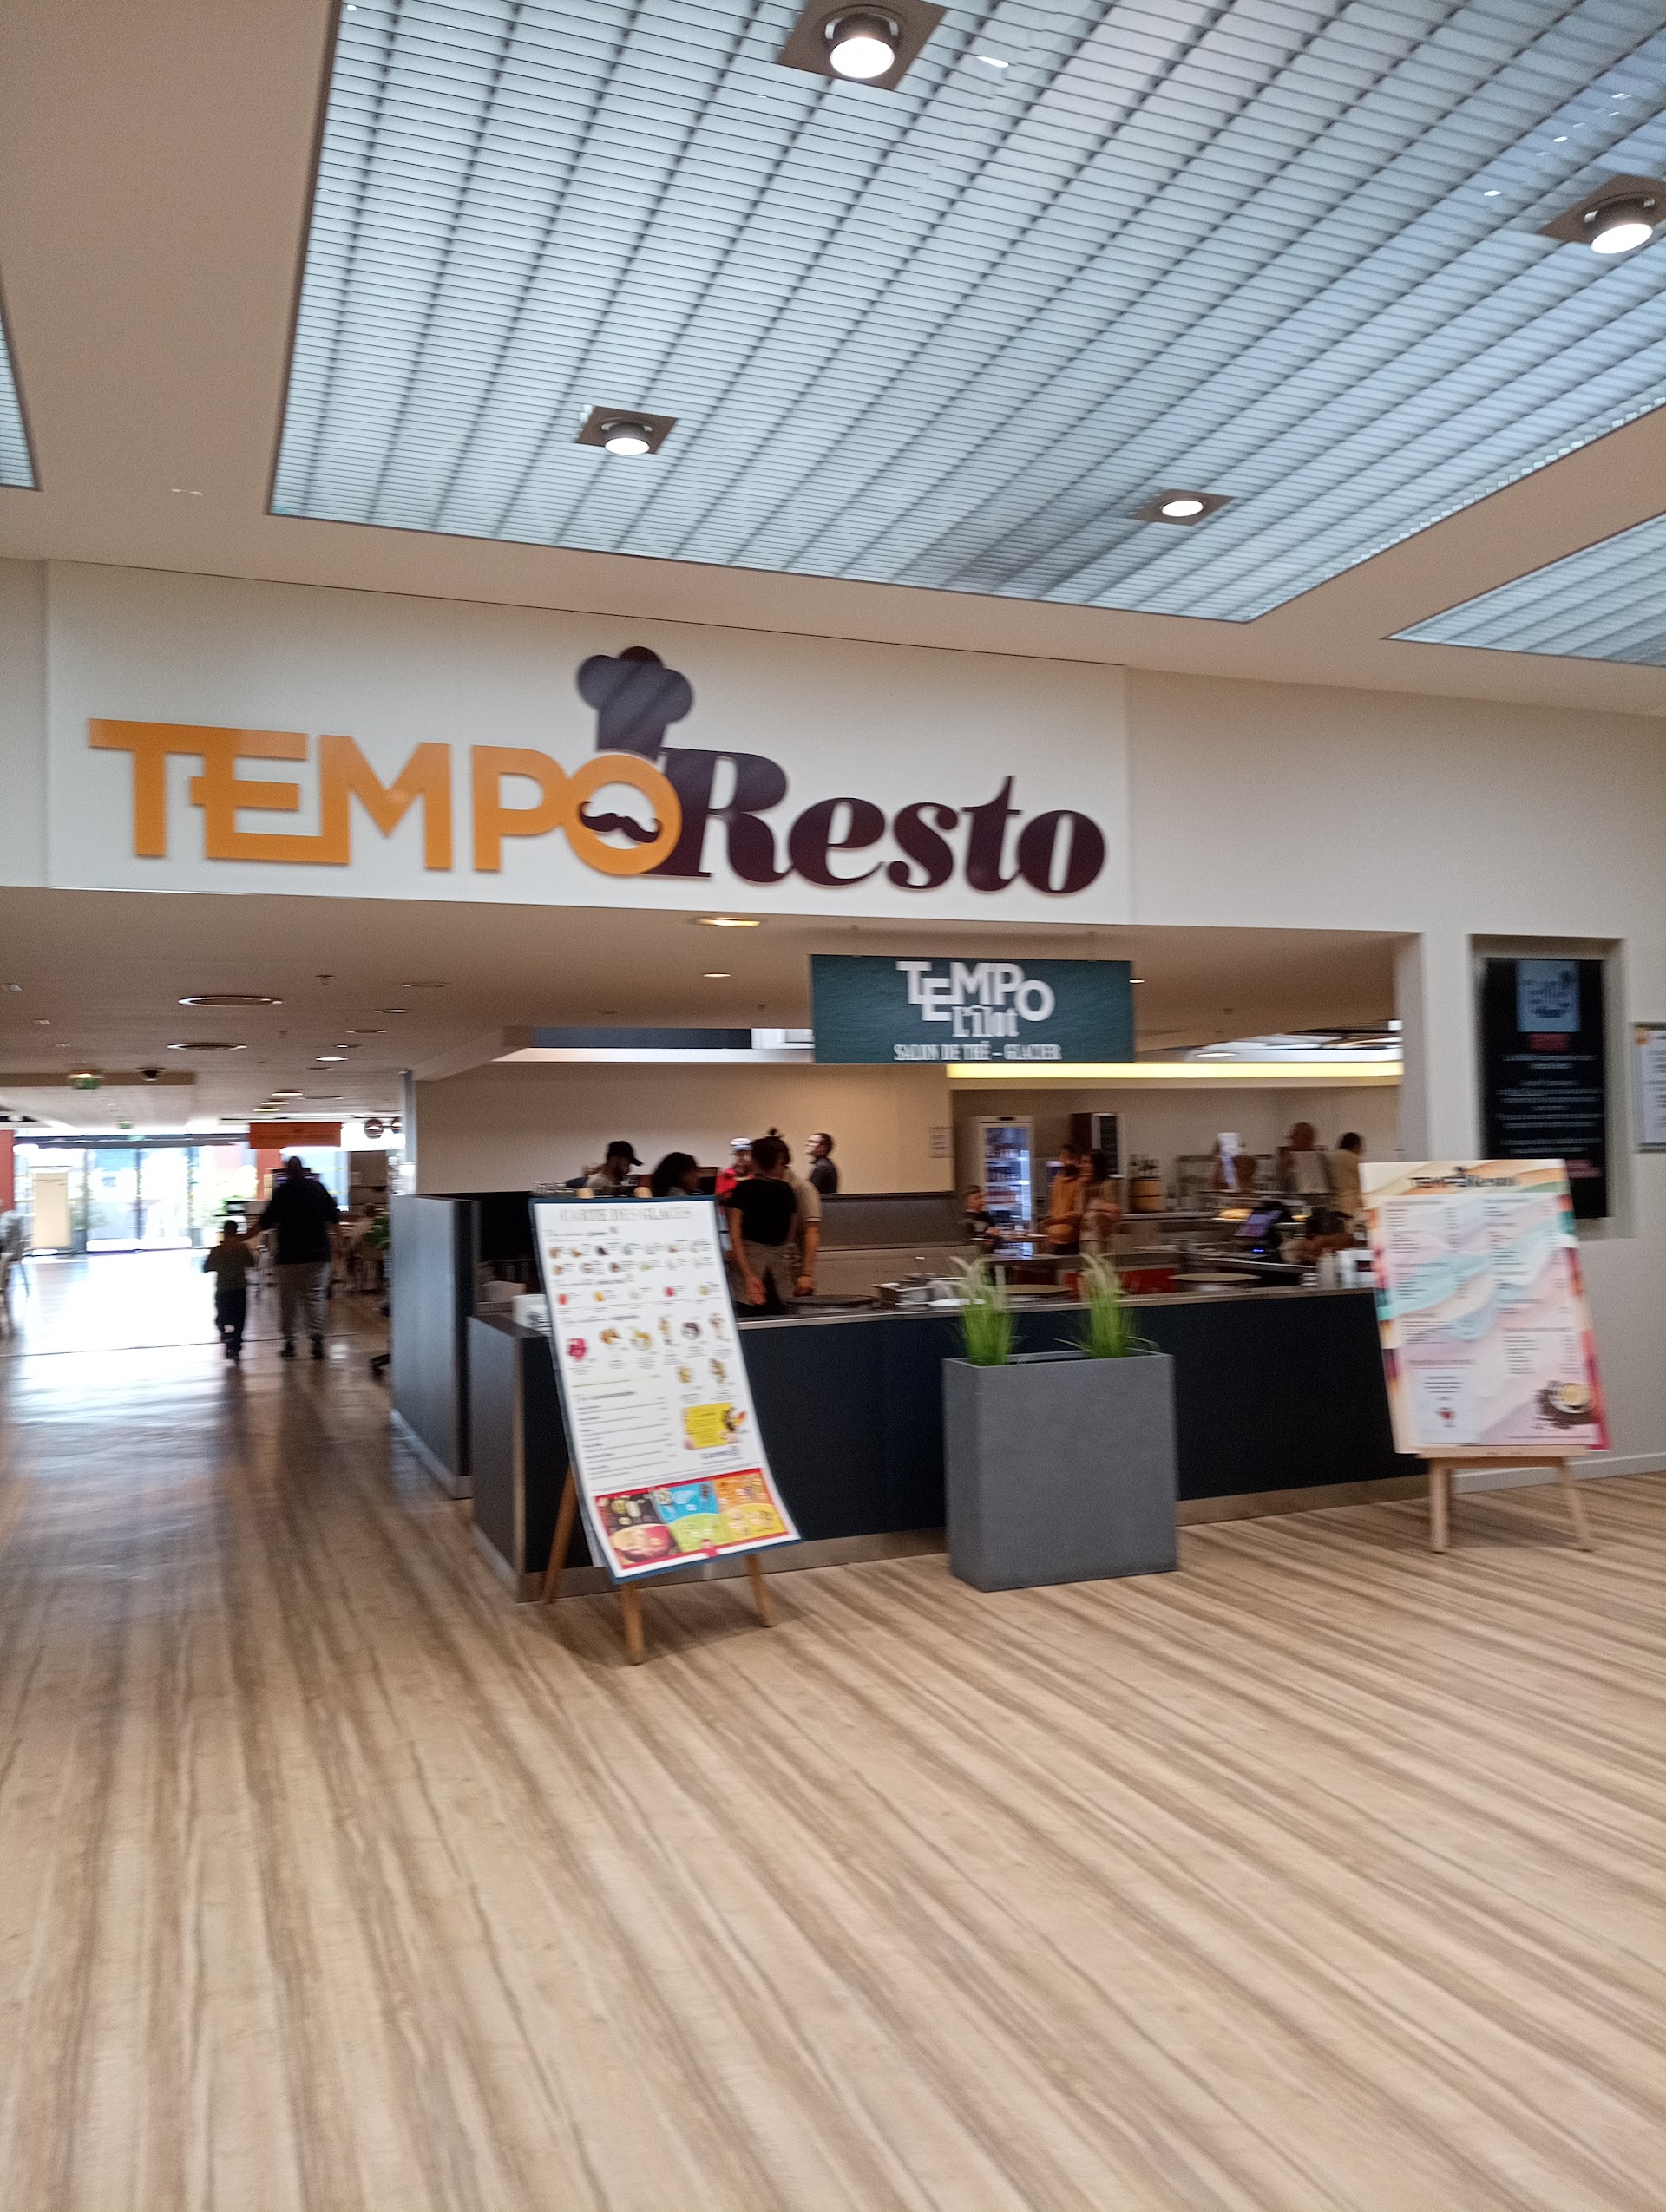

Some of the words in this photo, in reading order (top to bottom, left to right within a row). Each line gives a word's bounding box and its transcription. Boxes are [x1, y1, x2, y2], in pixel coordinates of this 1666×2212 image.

[88, 717, 682, 876] TEMPO
[640, 746, 1105, 895] Resto
[895, 960, 1056, 1022] TEMPO
[893, 1044, 941, 1061] SALON
[941, 1044, 962, 1061] DE
